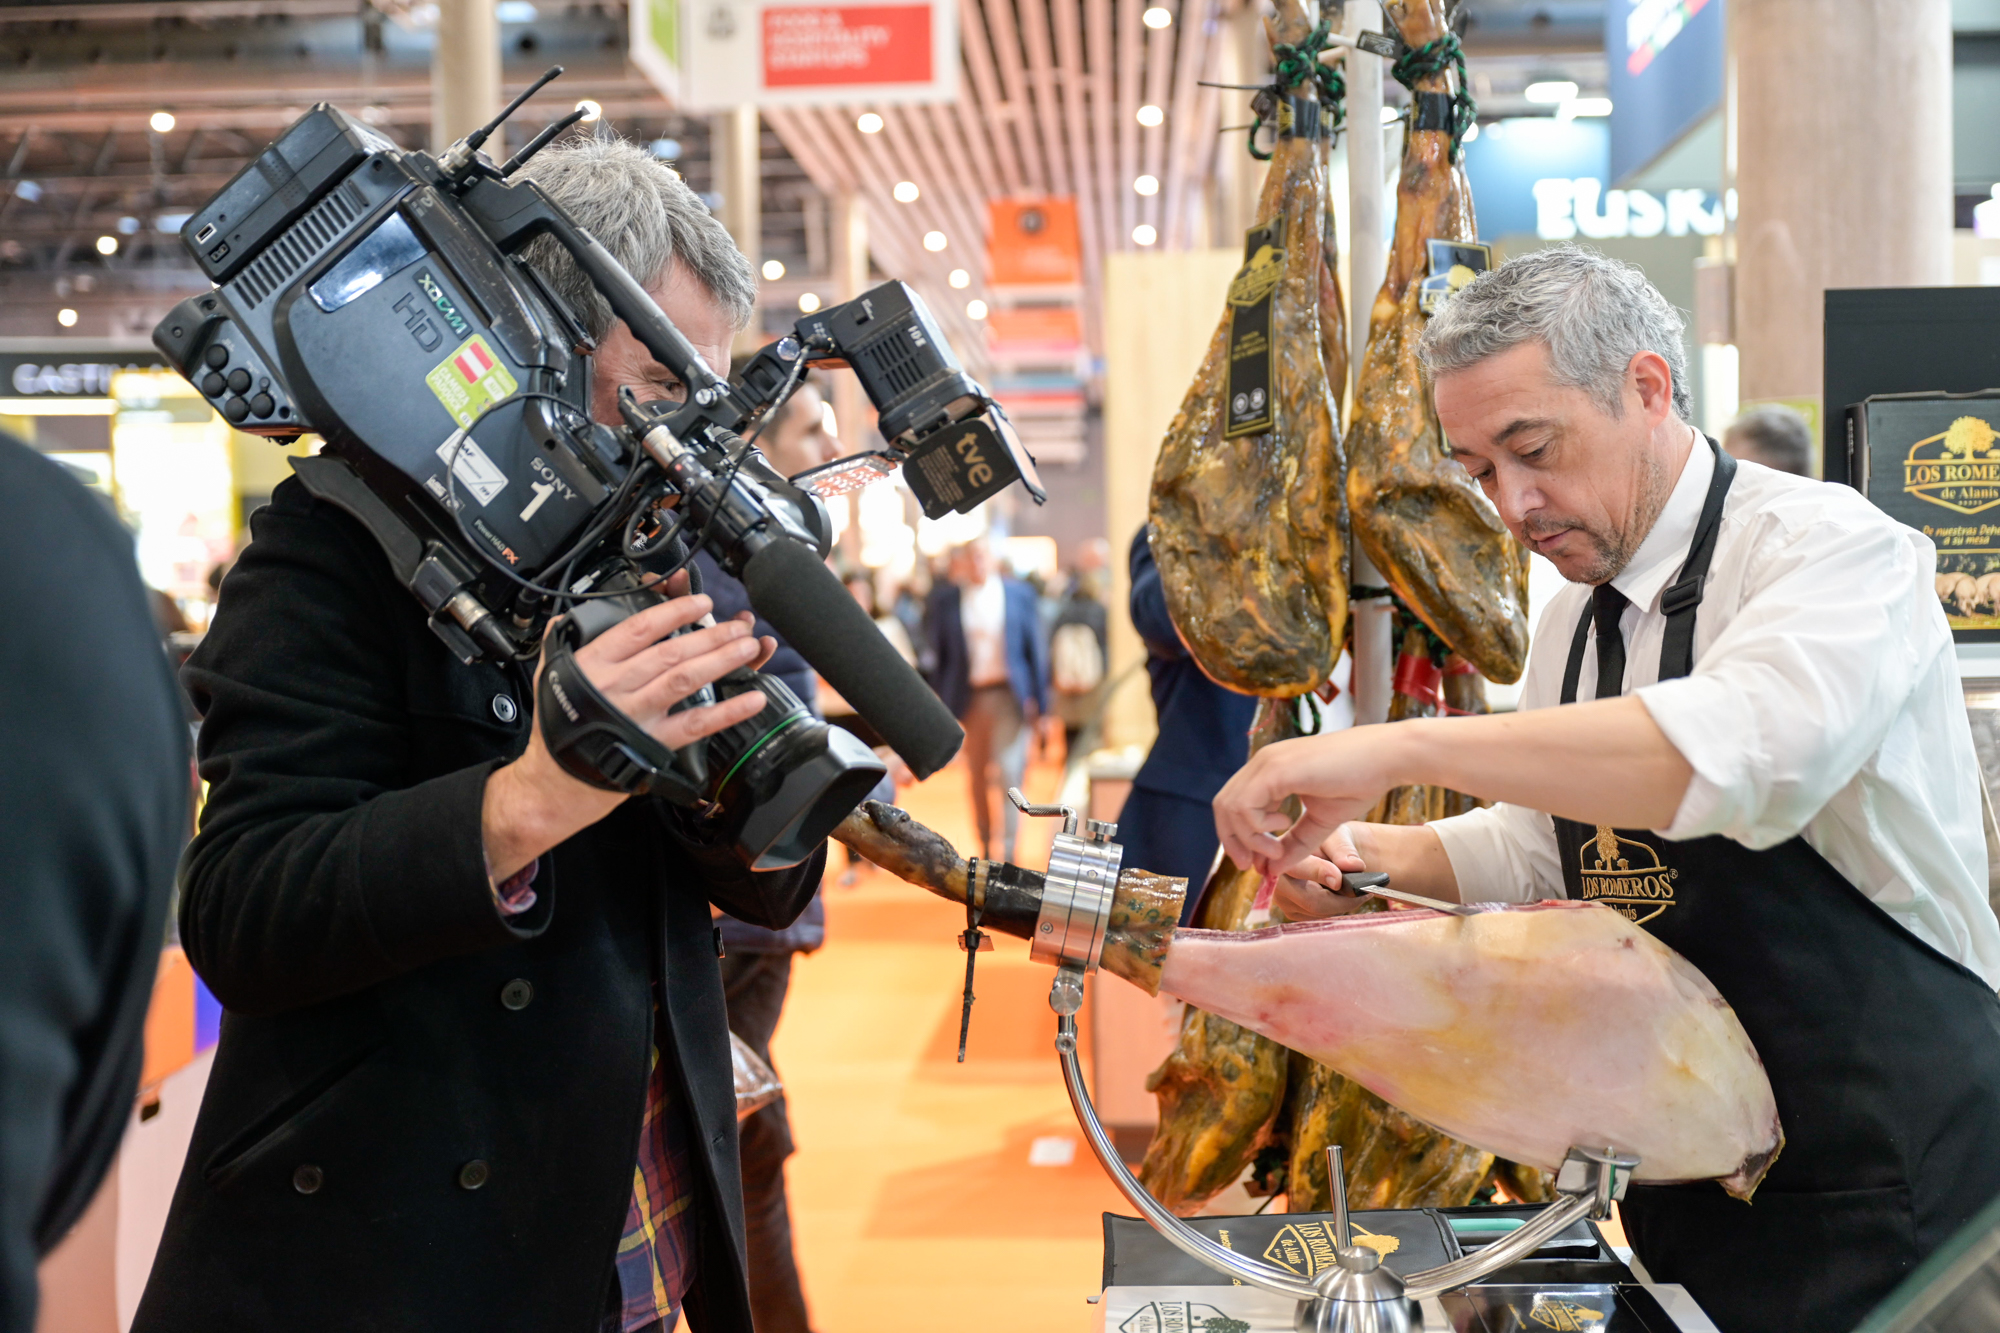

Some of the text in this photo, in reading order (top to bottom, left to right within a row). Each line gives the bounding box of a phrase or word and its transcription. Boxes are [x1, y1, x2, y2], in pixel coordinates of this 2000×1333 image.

[418, 273, 468, 334] XDCAM
[392, 292, 443, 353] HD
[956, 432, 993, 488] tve
[530, 457, 578, 501] SONY
[1905, 465, 1941, 486] LOS
[519, 481, 555, 522] 1
[1941, 486, 1956, 499] de
[473, 518, 493, 541] Power
[1923, 525, 1935, 536] De
[1935, 526, 1978, 537] nuestras
[1943, 536, 1990, 546] a su mesa
[549, 670, 579, 722] Canon
[1581, 872, 1674, 899] LOS ROMEROS
[1295, 1222, 1325, 1238] LOS
[1281, 1239, 1297, 1247] de
[1159, 1301, 1183, 1316] LOS
